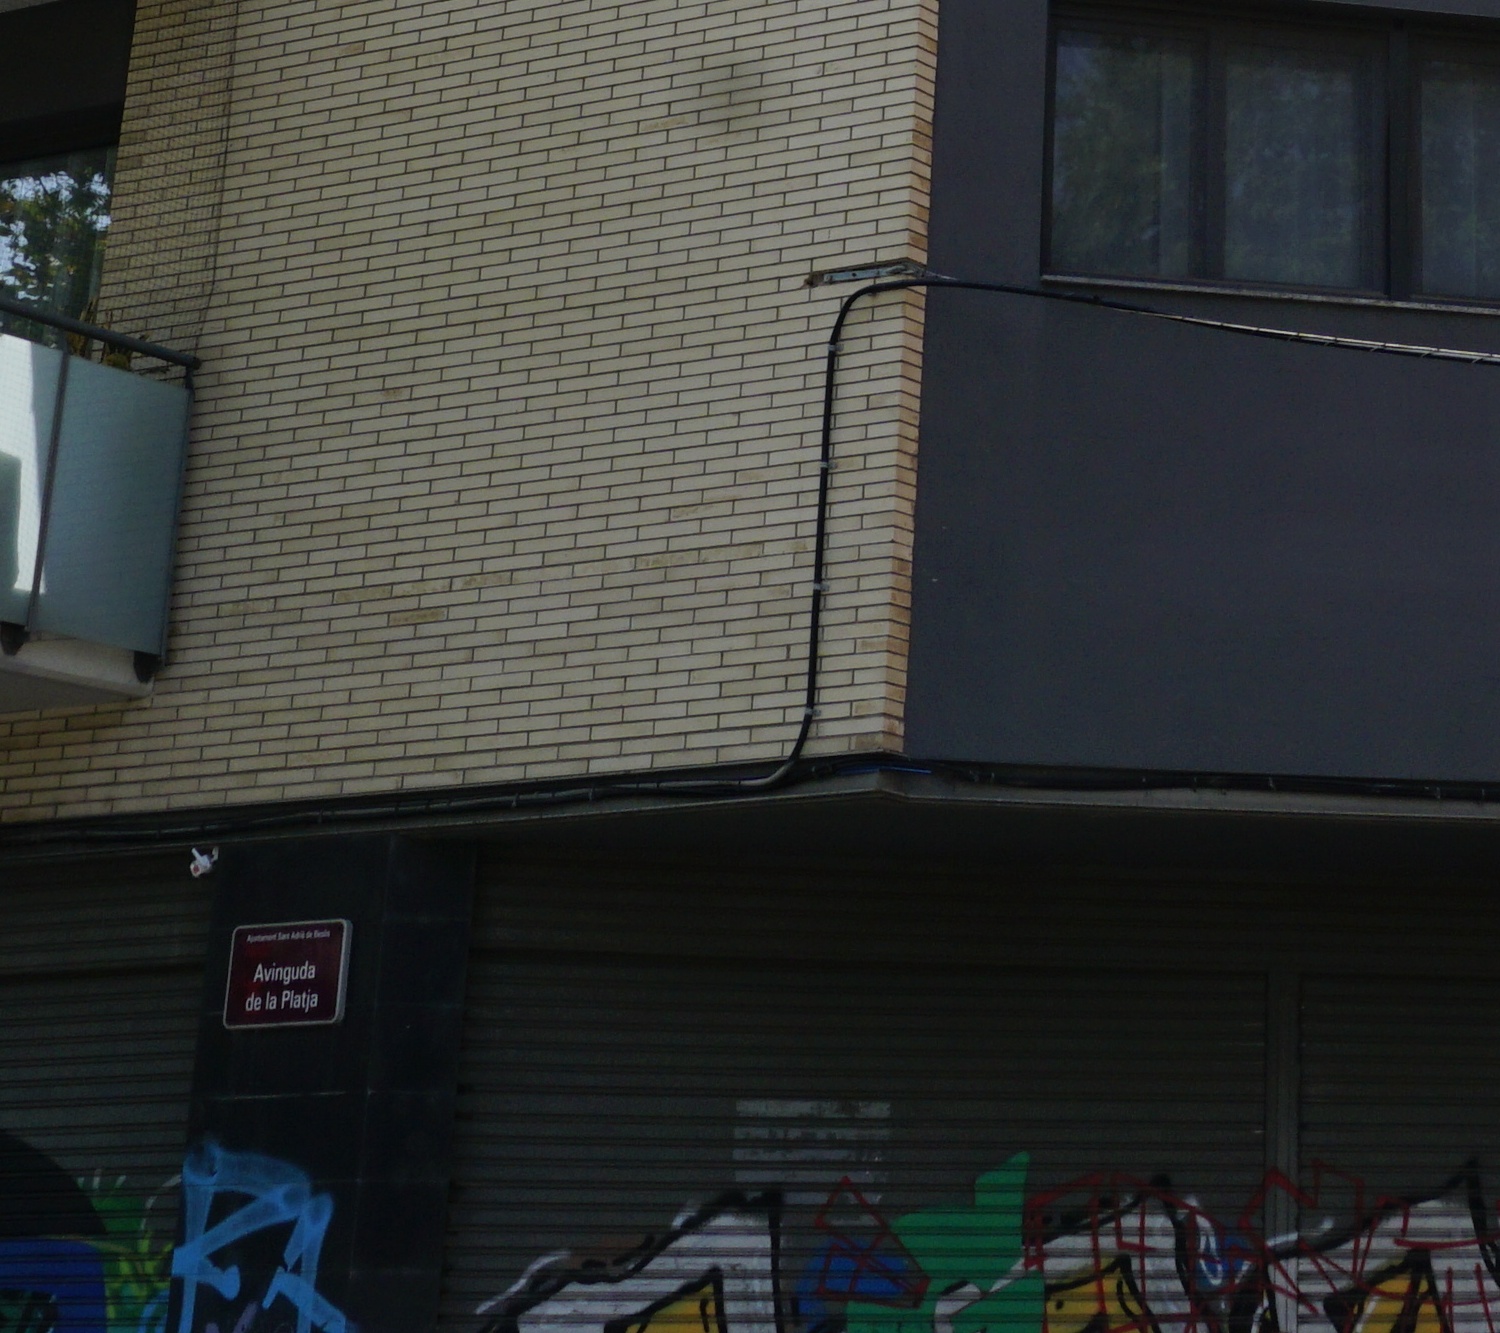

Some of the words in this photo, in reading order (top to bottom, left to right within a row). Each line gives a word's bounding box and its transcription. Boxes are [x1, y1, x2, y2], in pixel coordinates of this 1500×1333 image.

[253, 959, 316, 985] Avinguda
[245, 991, 262, 1012] de
[265, 990, 277, 1011] la
[281, 988, 318, 1013] Platja
